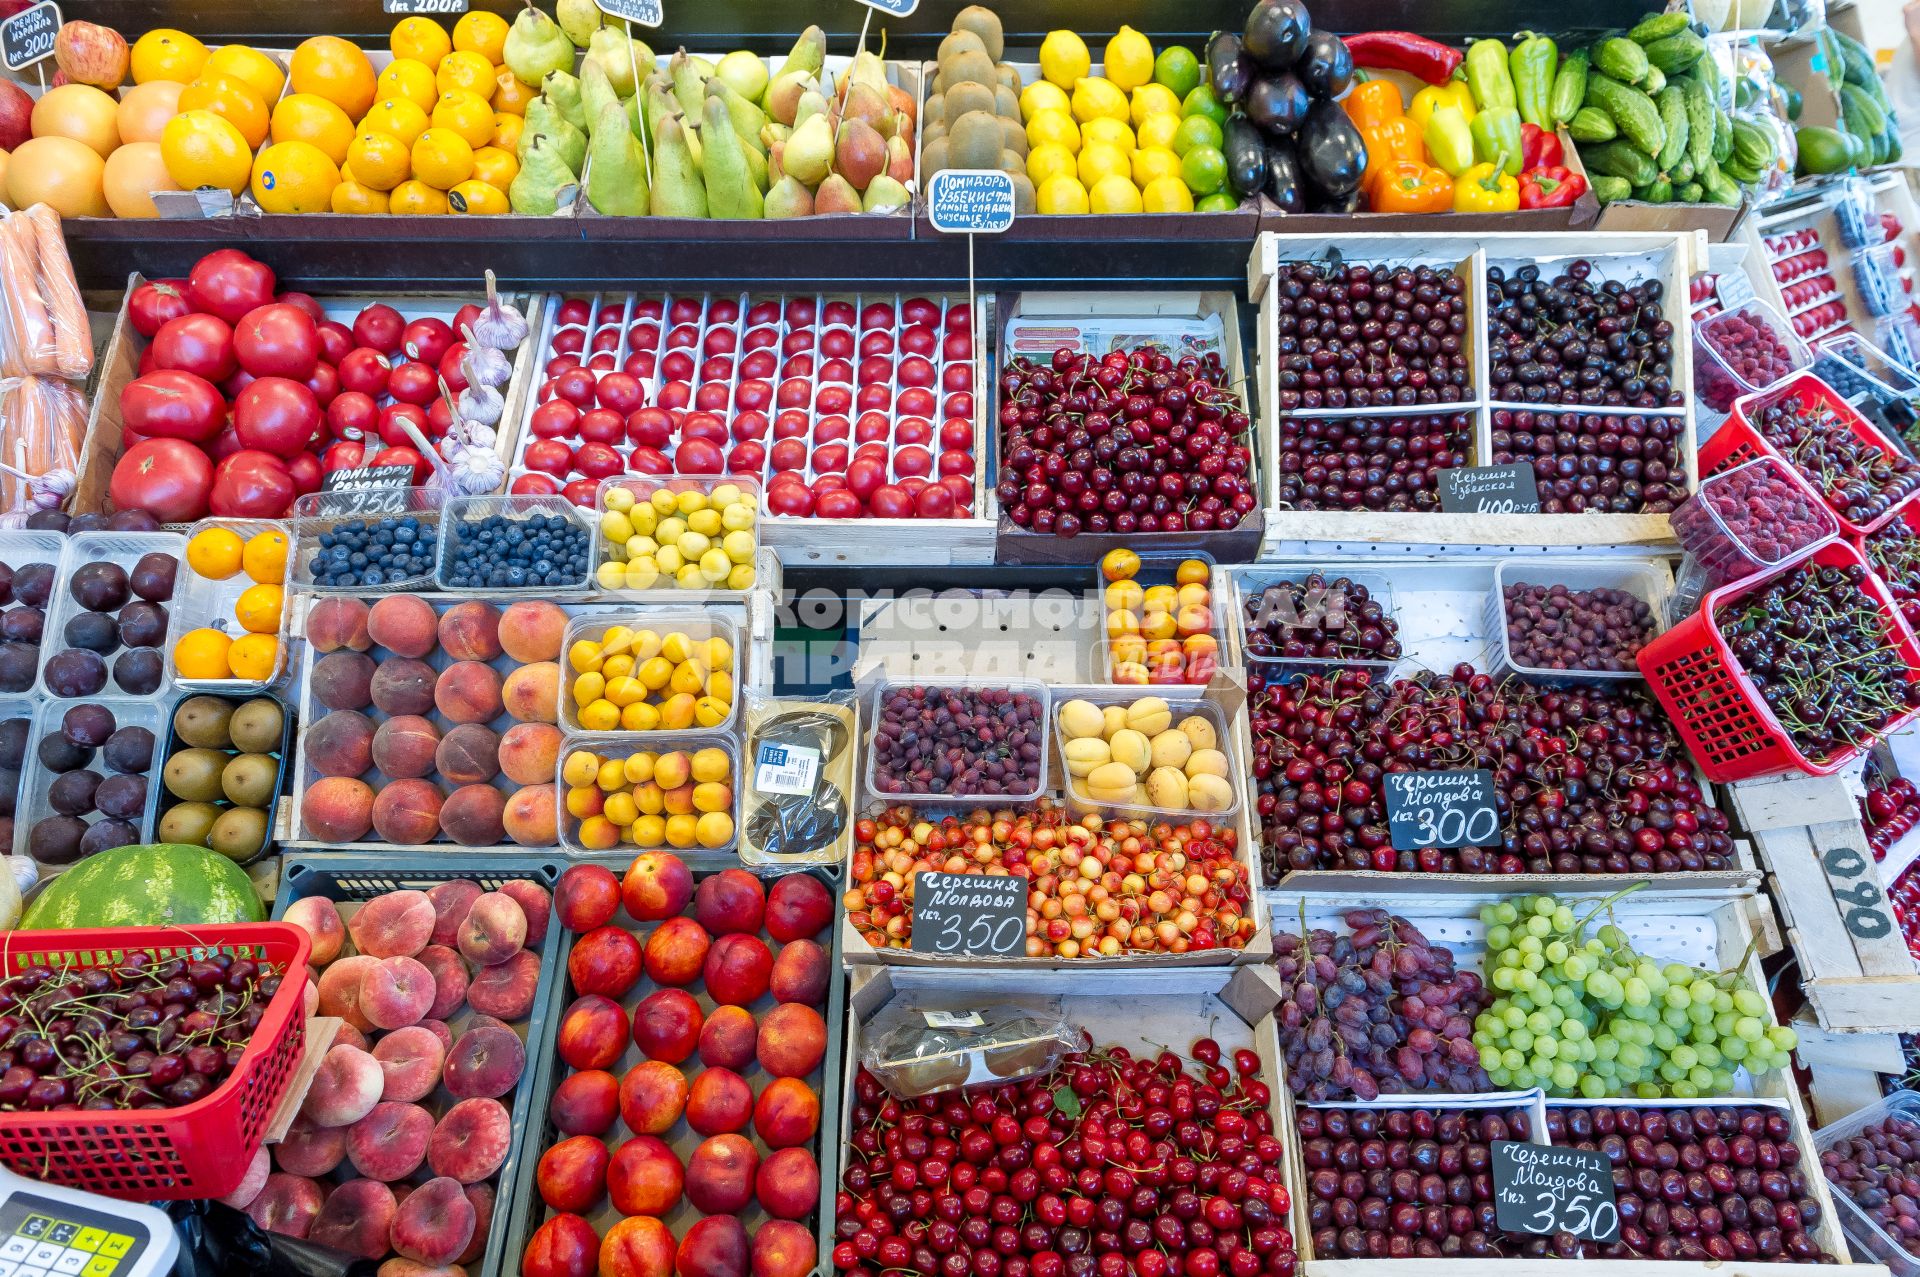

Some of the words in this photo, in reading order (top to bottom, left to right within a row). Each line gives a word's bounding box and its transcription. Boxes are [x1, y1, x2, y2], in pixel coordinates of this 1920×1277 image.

[940, 175, 1009, 190] ПОМИДОРЫ
[1450, 470, 1516, 485] Черешня
[1449, 482, 1515, 500] Узбекская
[1391, 773, 1481, 795] Черешня
[1402, 786, 1483, 810] Молдова
[1413, 807, 1498, 845] 300
[921, 872, 1020, 894] Черешня
[935, 914, 1024, 953] 350
[1502, 1144, 1606, 1172] Черешня
[1511, 1165, 1604, 1200] Молдова
[1522, 1192, 1619, 1240] 350
